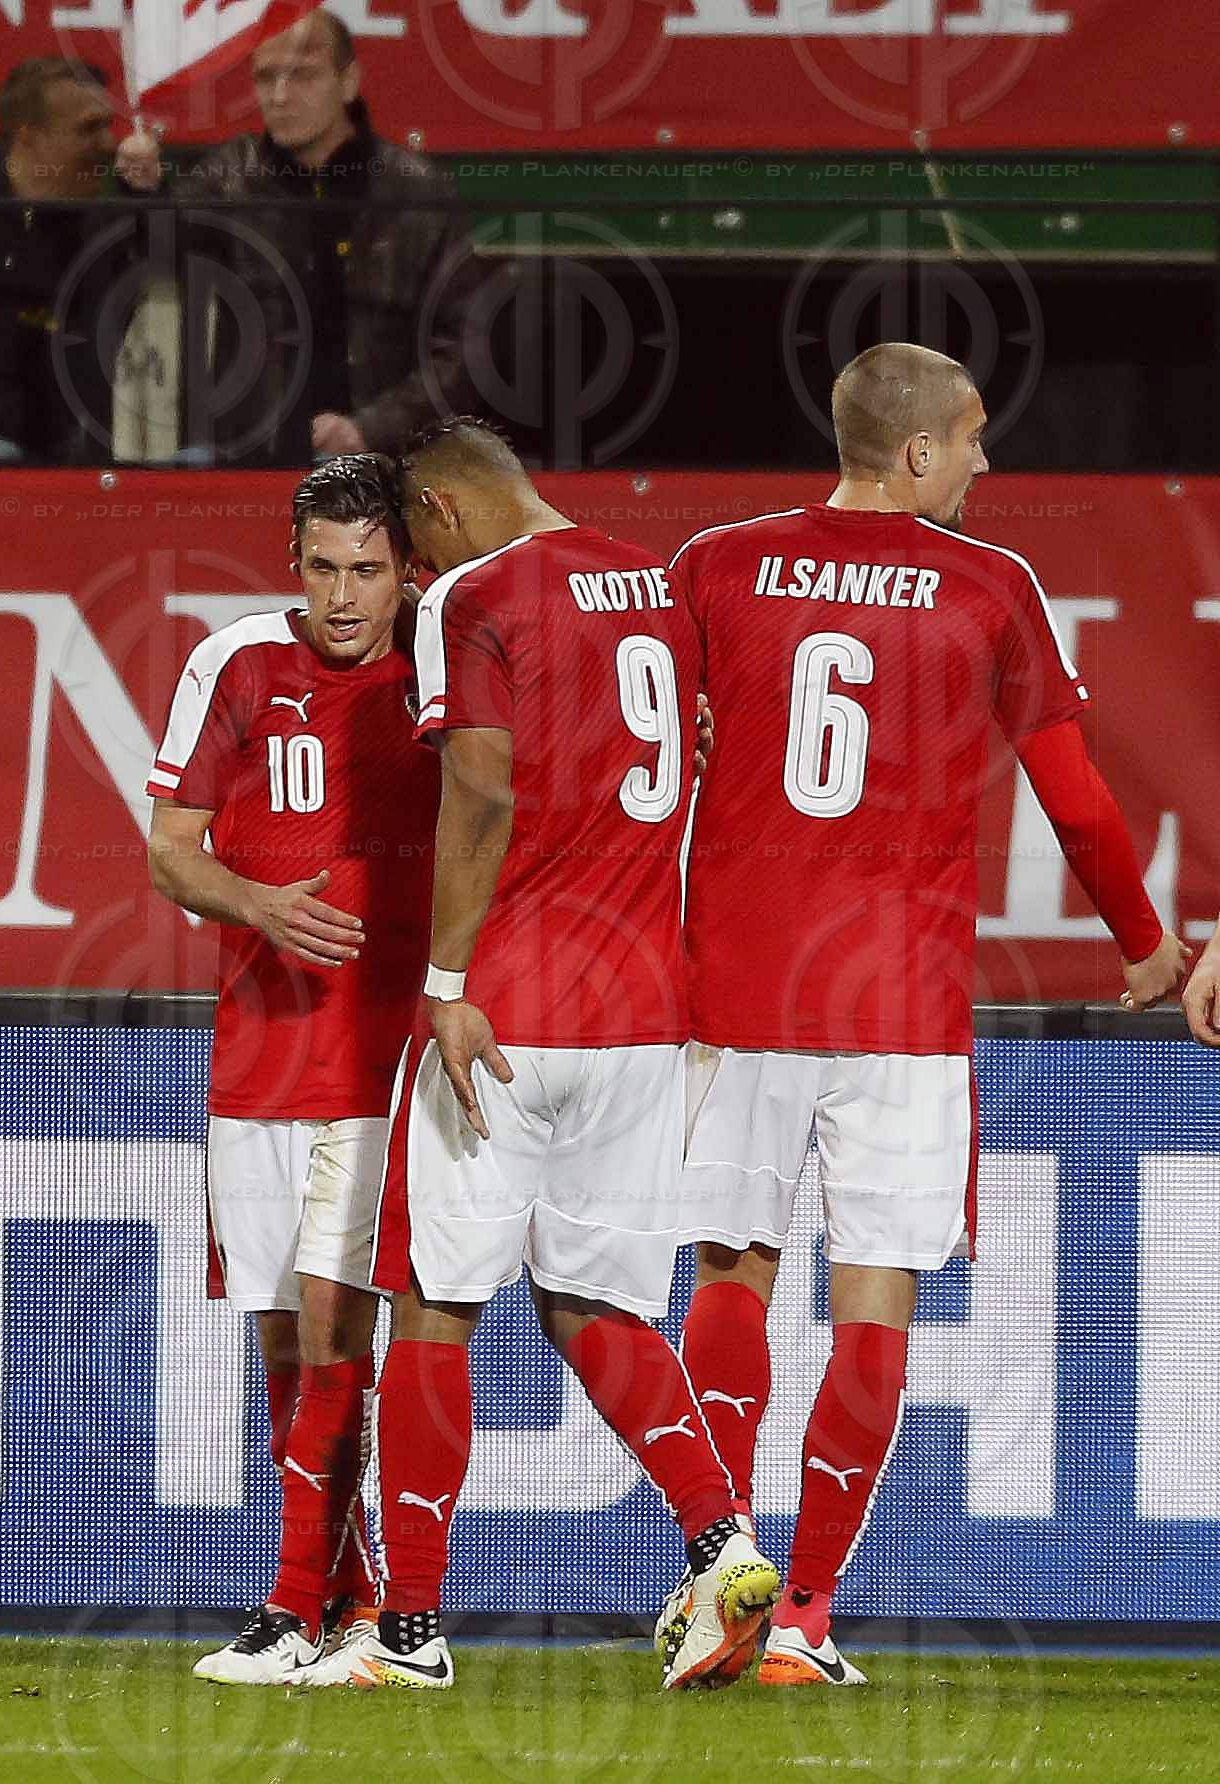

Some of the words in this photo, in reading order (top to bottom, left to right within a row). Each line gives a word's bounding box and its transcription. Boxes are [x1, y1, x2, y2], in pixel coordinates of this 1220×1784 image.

[568, 567, 674, 613] OKOTIE
[754, 556, 941, 609] ILSANKER
[615, 634, 680, 823] 9
[783, 631, 874, 819] 6
[267, 734, 325, 813] 10
